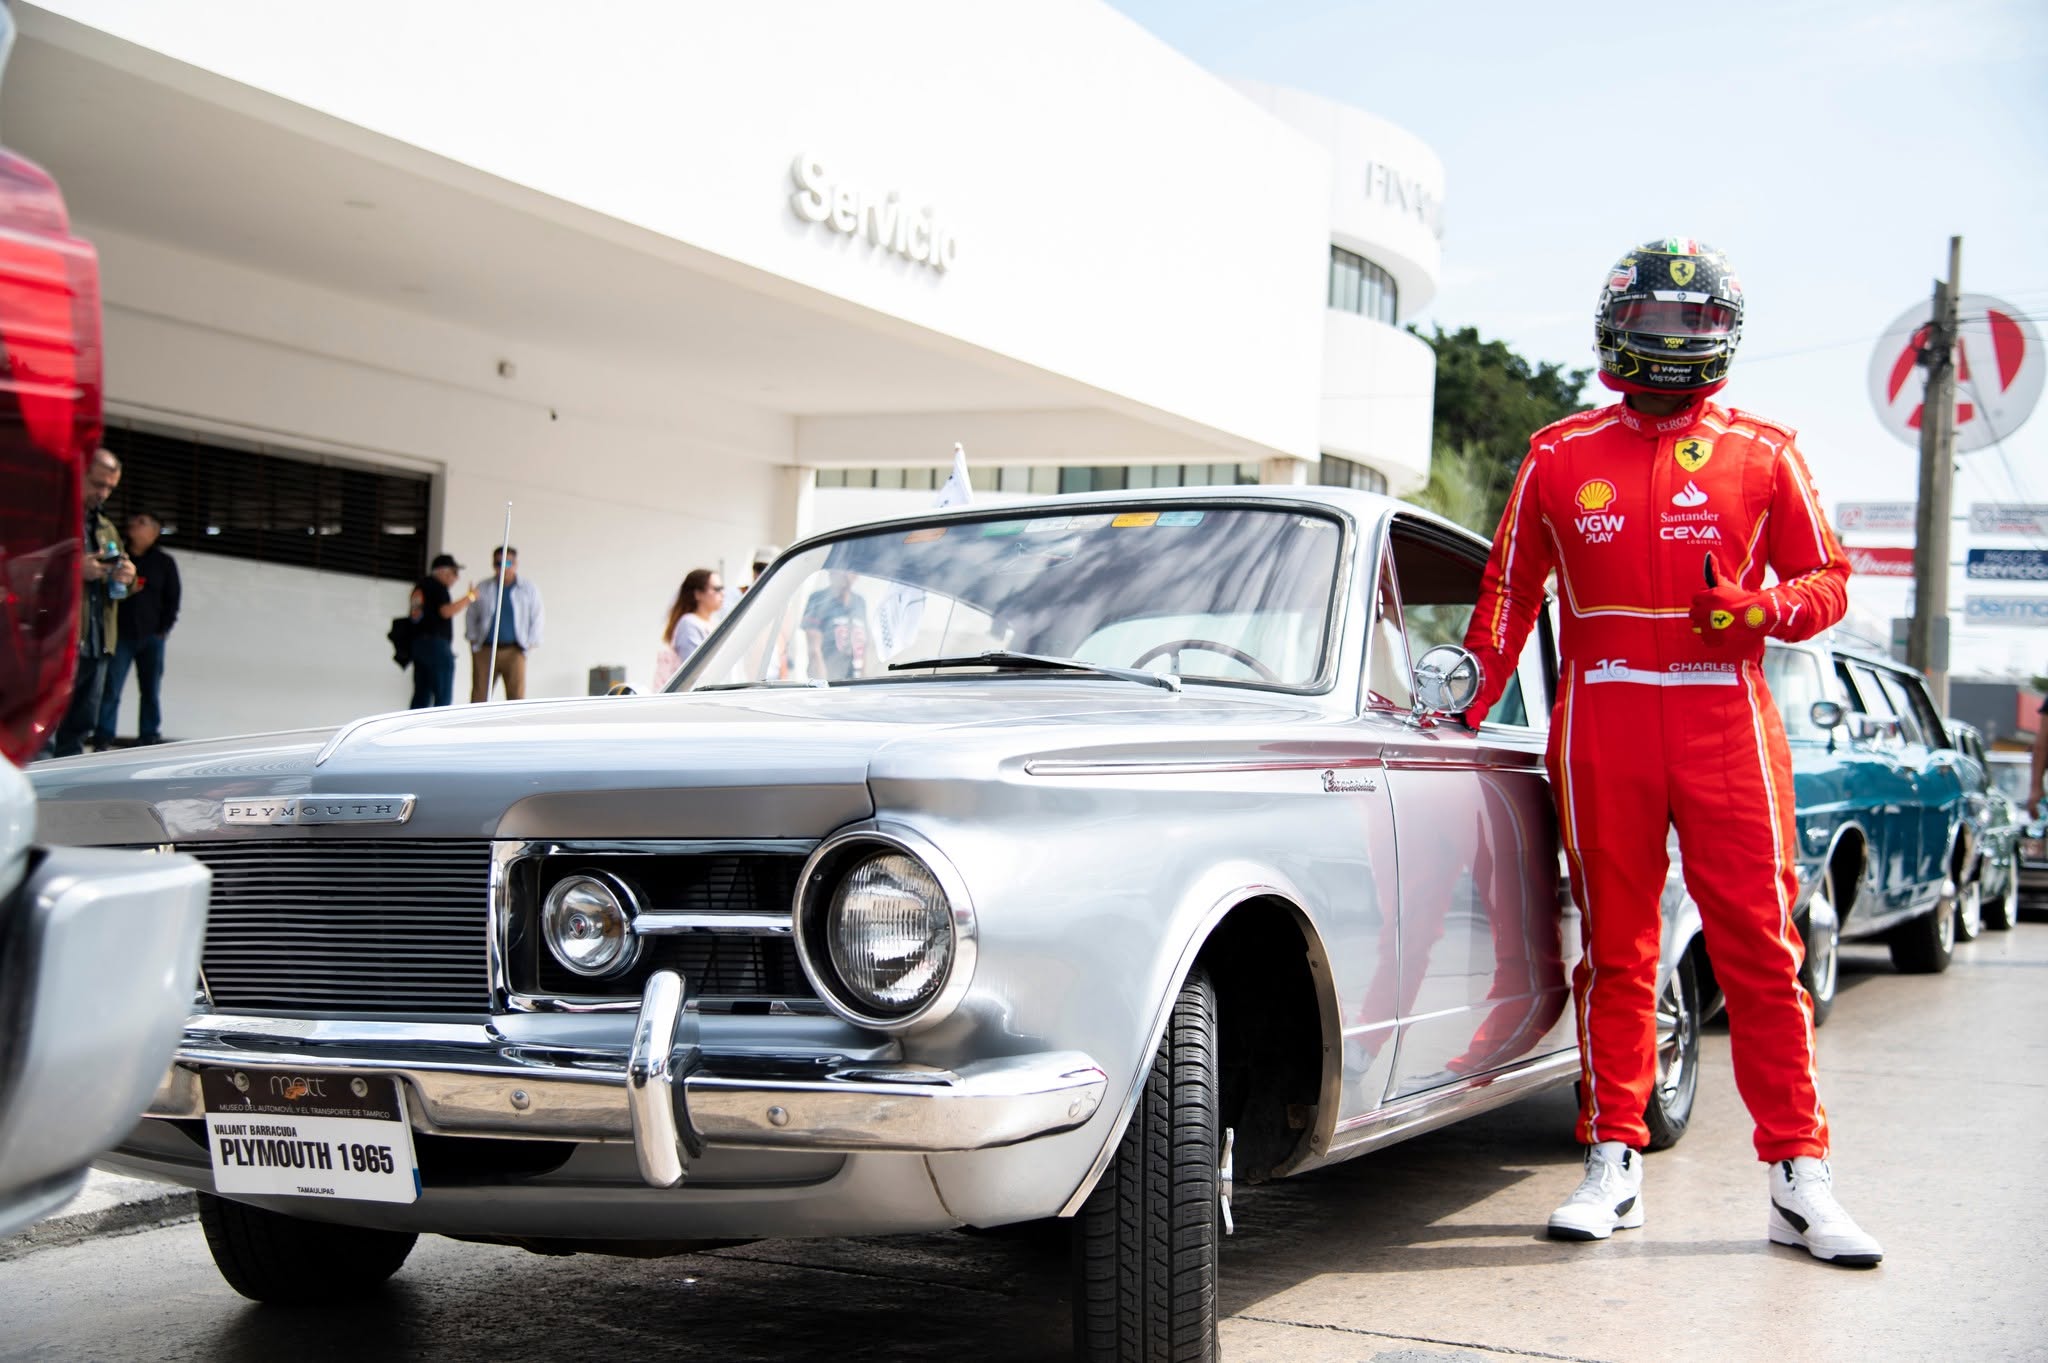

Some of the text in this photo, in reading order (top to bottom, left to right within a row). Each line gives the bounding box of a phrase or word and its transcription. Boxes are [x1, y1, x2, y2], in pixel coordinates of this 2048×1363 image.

[789, 150, 960, 274] Servicio
[1664, 337, 1684, 345] VGW
[1661, 365, 1692, 373] V-Power
[1660, 510, 1719, 523] Santander
[1574, 515, 1625, 534] VGW
[1585, 532, 1614, 544] PLAY
[1595, 658, 1736, 679] 16 CHARLES
[229, 805, 392, 817] PLYMOUTH
[245, 1104, 257, 1112] DEL
[310, 1107, 350, 1116] TRANSPORTE
[363, 1109, 390, 1118] TAMPICO
[214, 1124, 297, 1137] VALIANT BARRACUDA
[220, 1138, 394, 1174] PLYMOUTH 1965
[297, 1186, 335, 1195] TAMAULIPAS
